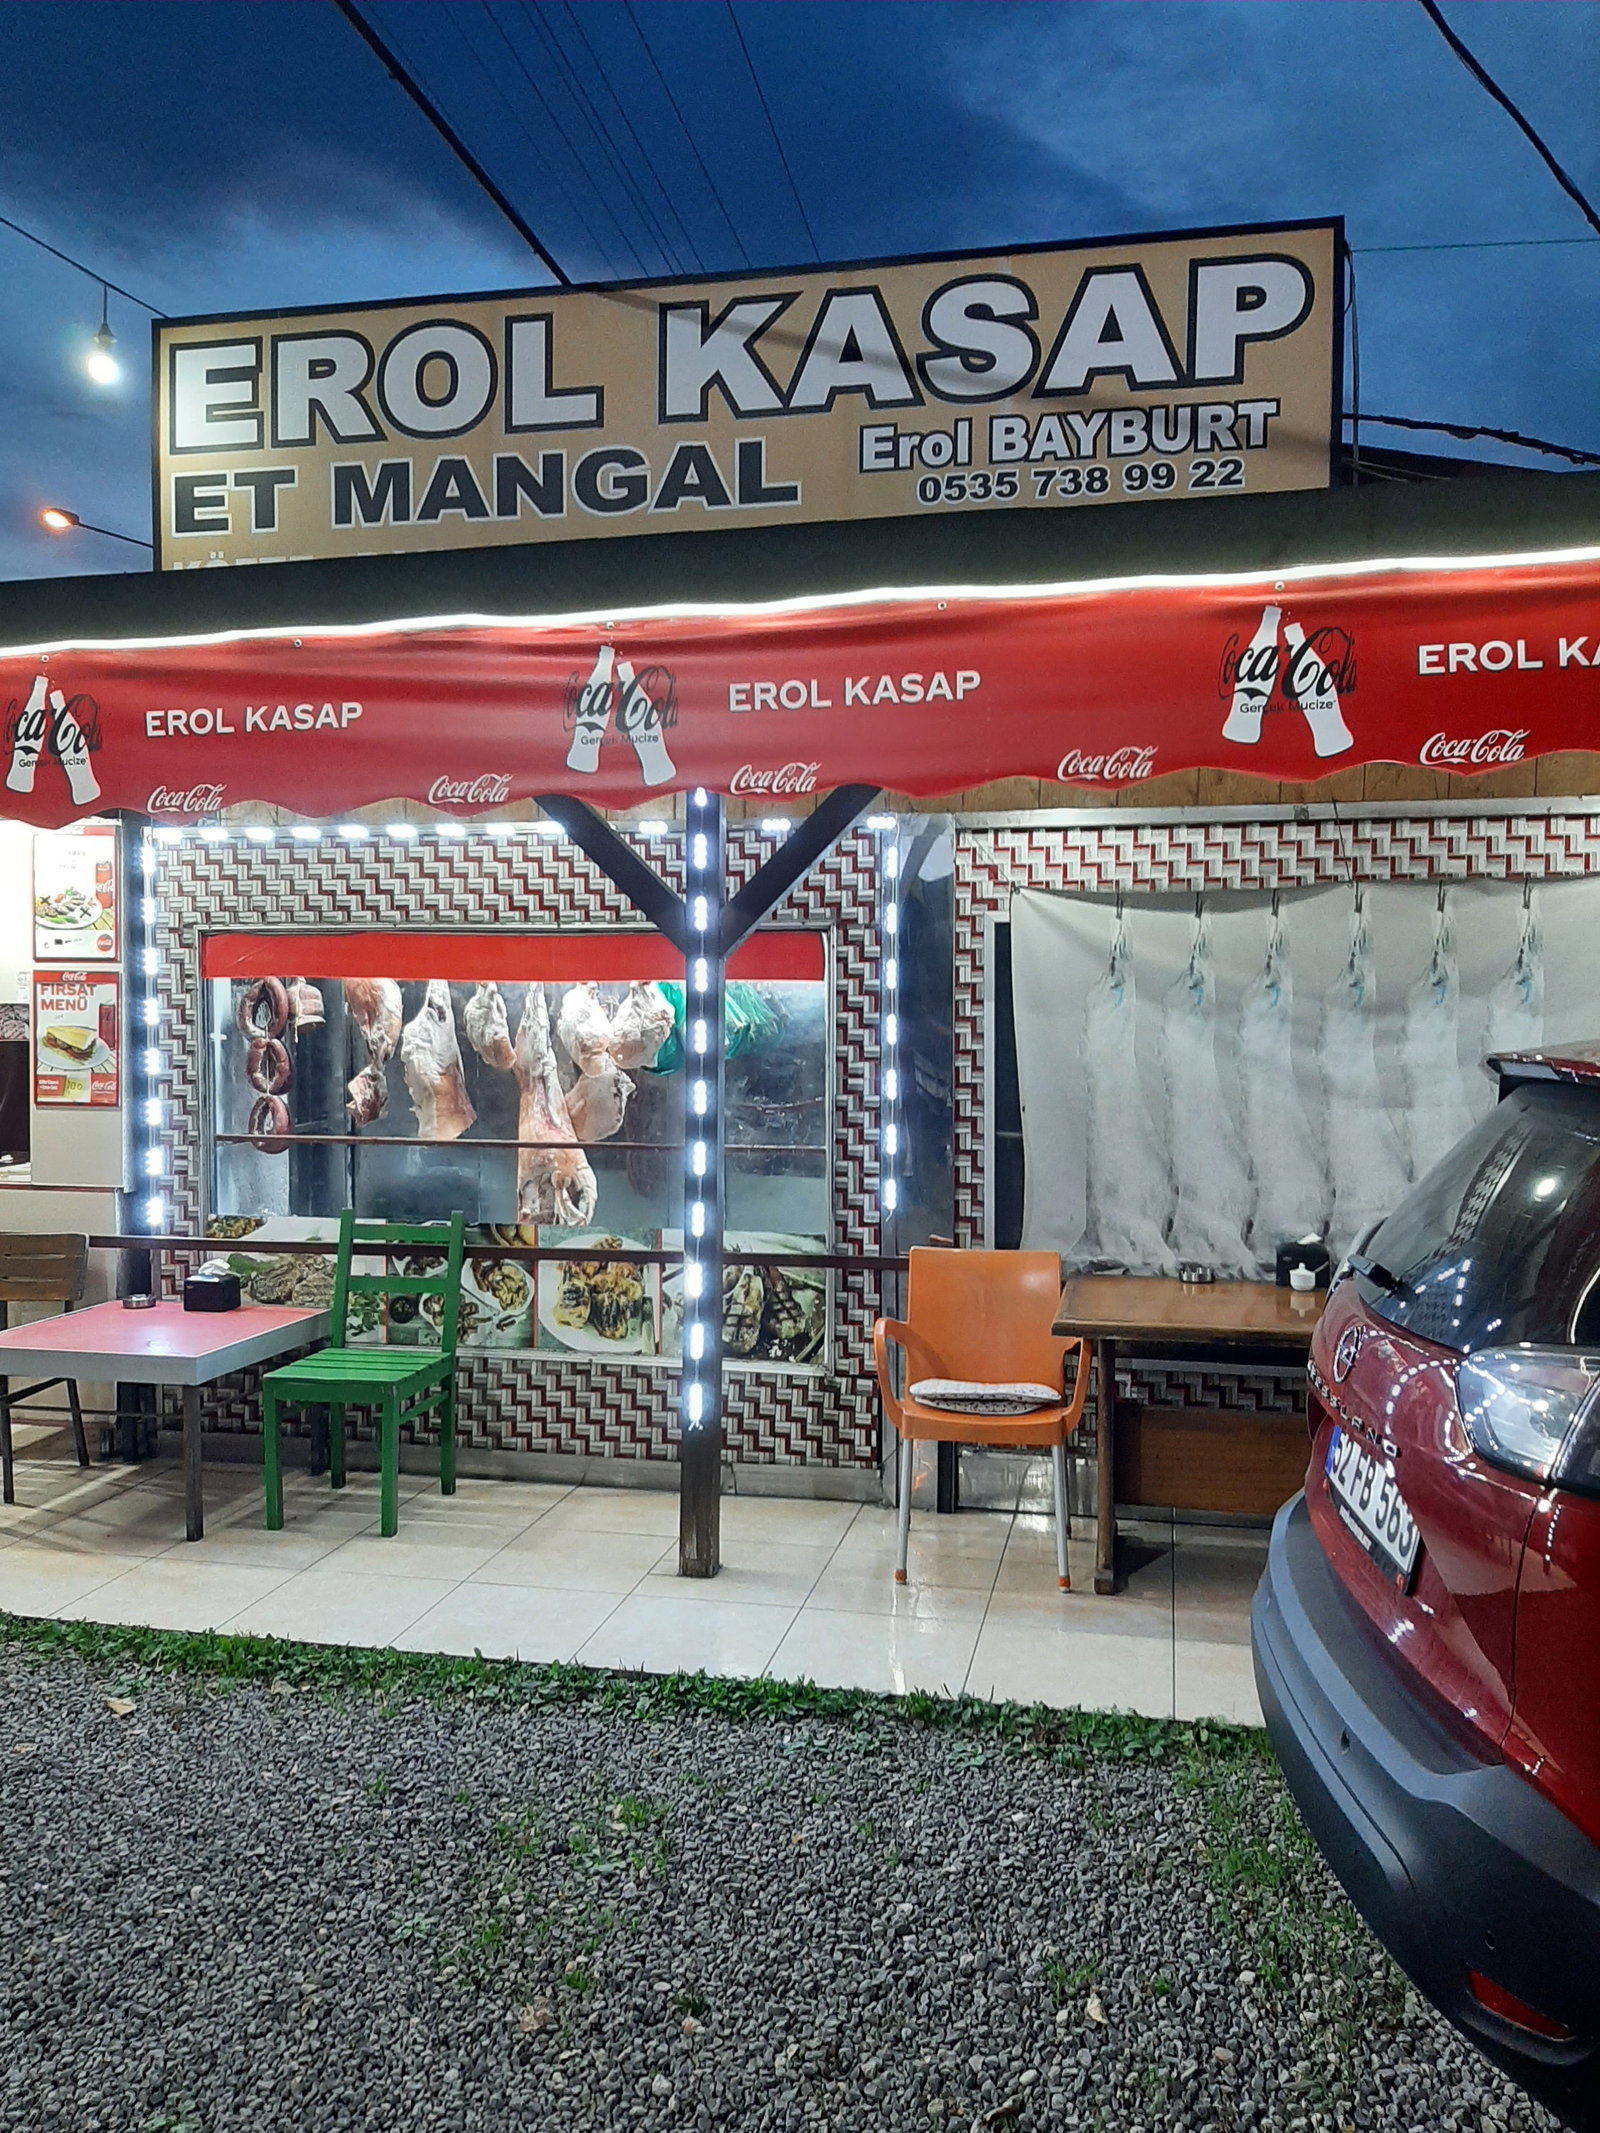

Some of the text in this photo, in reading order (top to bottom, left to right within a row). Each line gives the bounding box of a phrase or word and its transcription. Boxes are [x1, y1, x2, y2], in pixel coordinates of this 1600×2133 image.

[170, 253, 1315, 455] EROL KASAP
[859, 398, 1281, 473] Erol BAYBURT
[171, 436, 803, 538] ET MANGAL
[916, 456, 1245, 505] 0535 738 99 22
[1418, 639, 1544, 675] EROL
[728, 669, 981, 712] EROL KASAP
[1288, 699, 1334, 712] Mucize
[145, 701, 364, 738] EROL KASAP
[1056, 745, 1159, 782] Coca-Cola
[1418, 728, 1531, 766] Coca-Cola
[427, 772, 514, 805] Coca-Cola
[730, 761, 823, 796] Coca-Cola
[146, 782, 228, 813] Coca-Cola
[41, 983, 97, 996] FIRSAT
[41, 994, 88, 1011] MENÜ
[1350, 1449, 1377, 1512] FB
[1375, 1475, 1416, 1558] 563
